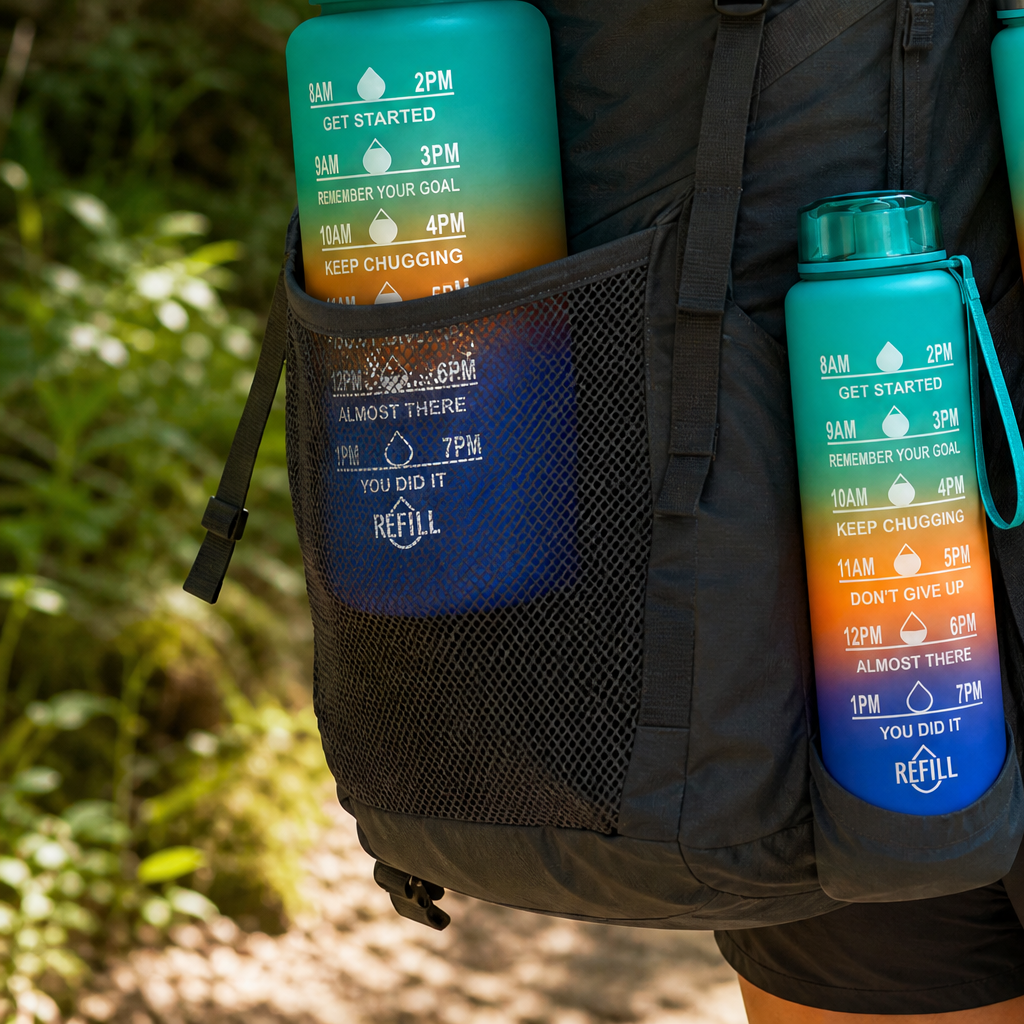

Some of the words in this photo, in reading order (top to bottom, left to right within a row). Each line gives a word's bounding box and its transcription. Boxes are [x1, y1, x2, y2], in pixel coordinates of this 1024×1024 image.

[309, 81, 333, 103] 8AM
[415, 69, 453, 92] 2PM
[323, 115, 349, 131] GET
[354, 106, 436, 128] STARTED
[315, 154, 339, 176] 9AM
[420, 142, 460, 166] 3PM
[318, 186, 374, 205] REMEMBER
[376, 183, 416, 199] YOUR
[419, 178, 460, 196] GOAL
[320, 223, 352, 246] 10AM
[426, 212, 465, 235] 4PM
[324, 258, 359, 276] KEEP
[363, 248, 463, 272] CHUGGING
[437, 359, 477, 384] 6PM
[820, 354, 850, 374] 8AM
[926, 342, 953, 363] 2PM
[839, 385, 869, 399] GET
[874, 377, 943, 397] STARTED
[338, 404, 399, 422] ALMOST
[404, 397, 467, 418] THERE
[826, 420, 857, 440] 9AM
[932, 408, 959, 430] 3PM
[442, 433, 483, 458] 7PM
[829, 450, 893, 468] REMEMBER
[896, 446, 930, 461] YOUR
[932, 441, 961, 457] GOAL
[361, 477, 391, 494] YOU
[396, 474, 425, 491] DID
[431, 472, 447, 488] IT
[831, 487, 868, 508] 10AM
[937, 475, 965, 496] 4PM
[373, 510, 441, 539] REFILL
[836, 520, 878, 537] KEEP
[883, 509, 965, 533] CHUGGING
[838, 557, 875, 578] 11AM
[944, 545, 971, 567] 5PM
[851, 589, 899, 606] DON'T
[903, 583, 941, 602] GIVE
[945, 580, 964, 594] UP
[844, 625, 883, 646] 12PM
[950, 612, 977, 636] 6PM
[856, 655, 921, 673] ALMOST
[925, 647, 972, 668] THERE
[850, 694, 881, 715] 1PM
[956, 680, 983, 704] 7PM
[879, 724, 913, 740] YOU
[918, 720, 945, 737] DID
[949, 717, 962, 732] IT
[895, 756, 958, 784] REFILL
